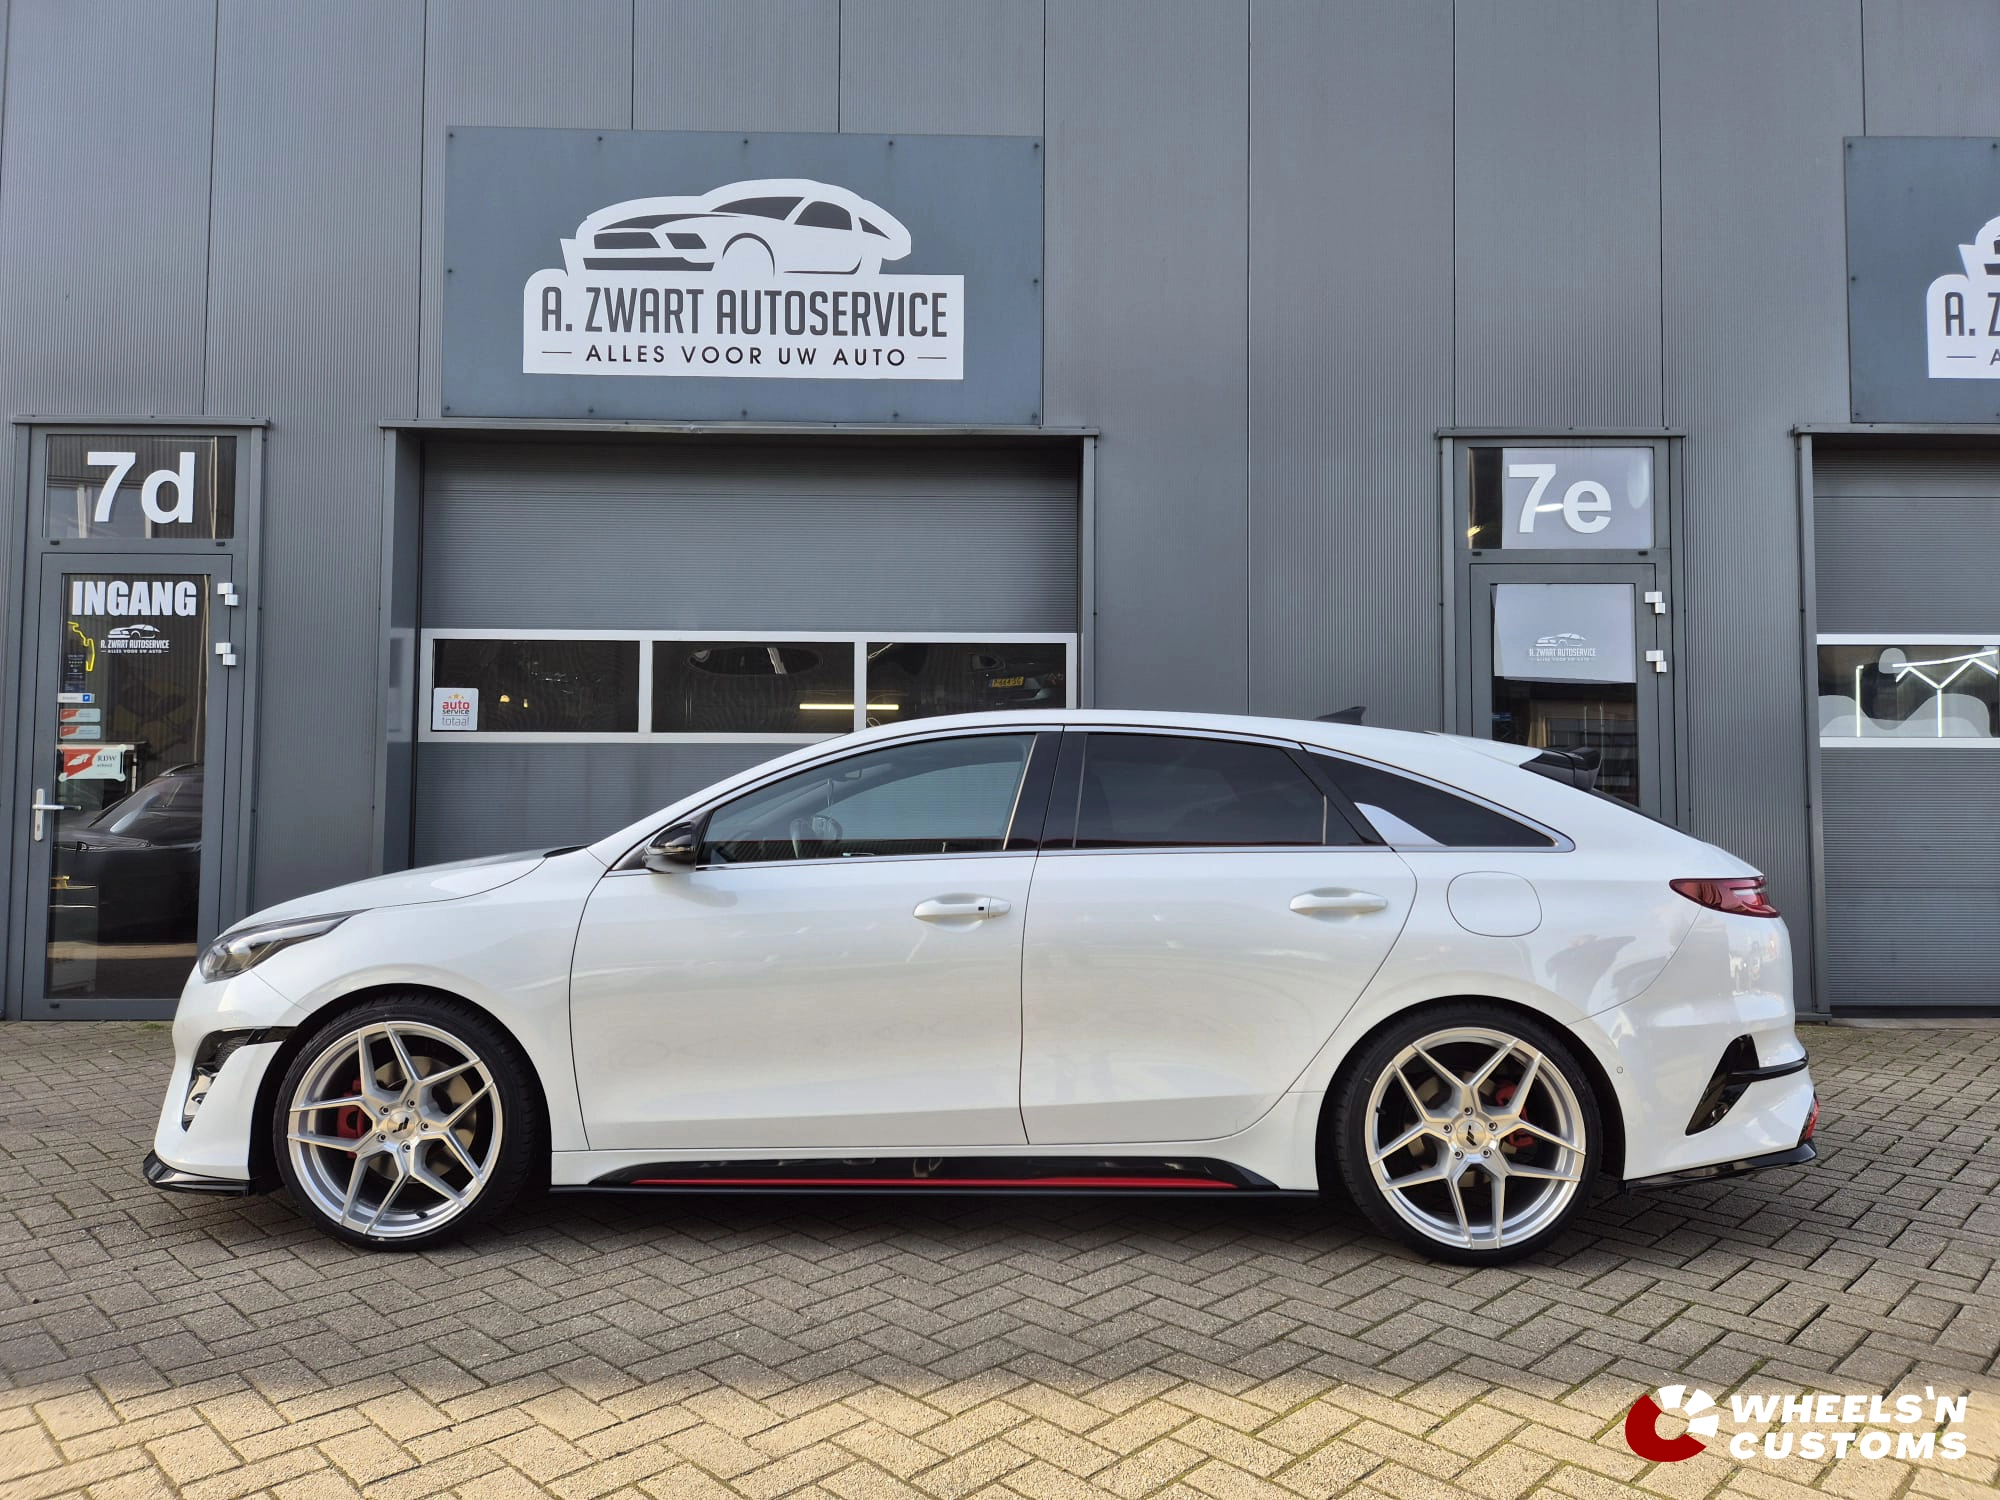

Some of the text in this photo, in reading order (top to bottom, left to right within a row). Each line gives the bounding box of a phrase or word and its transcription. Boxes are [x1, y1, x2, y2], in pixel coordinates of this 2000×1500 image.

[541, 286, 948, 337] A. ZWART AUTOSERVICE
[1945, 291, 1976, 336] A.
[585, 344, 906, 366] ALLES VOOR UW AUTO
[87, 451, 196, 524] 7d
[1507, 463, 1612, 534] 7e
[71, 581, 197, 616] INGANG
[442, 700, 470, 710] auto
[442, 716, 470, 727] totaal
